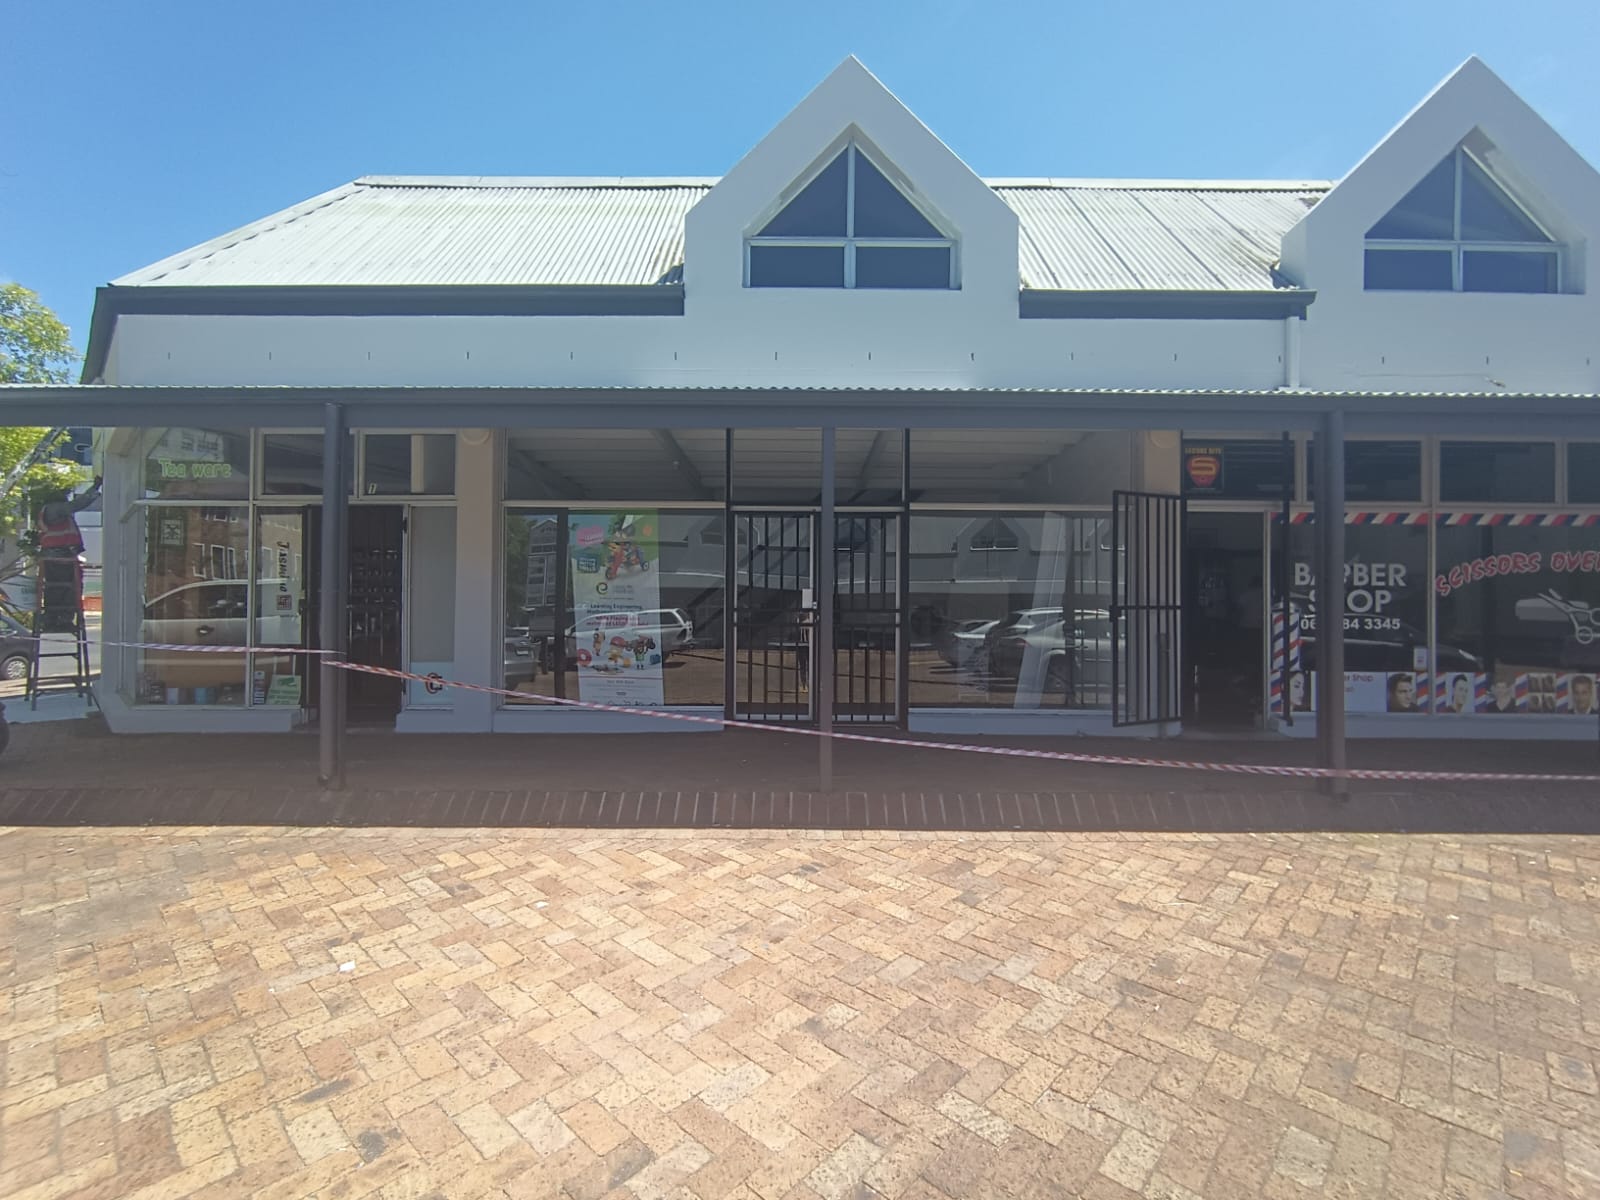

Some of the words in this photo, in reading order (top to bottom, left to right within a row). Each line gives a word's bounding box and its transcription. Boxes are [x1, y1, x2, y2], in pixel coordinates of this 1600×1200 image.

[159, 457, 186, 477] Tea
[192, 463, 232, 478] ware
[1294, 562, 1407, 587] BBER
[1435, 552, 1542, 597] SCISSORS
[1308, 589, 1392, 613] SOP
[1363, 618, 1401, 630] 3345
